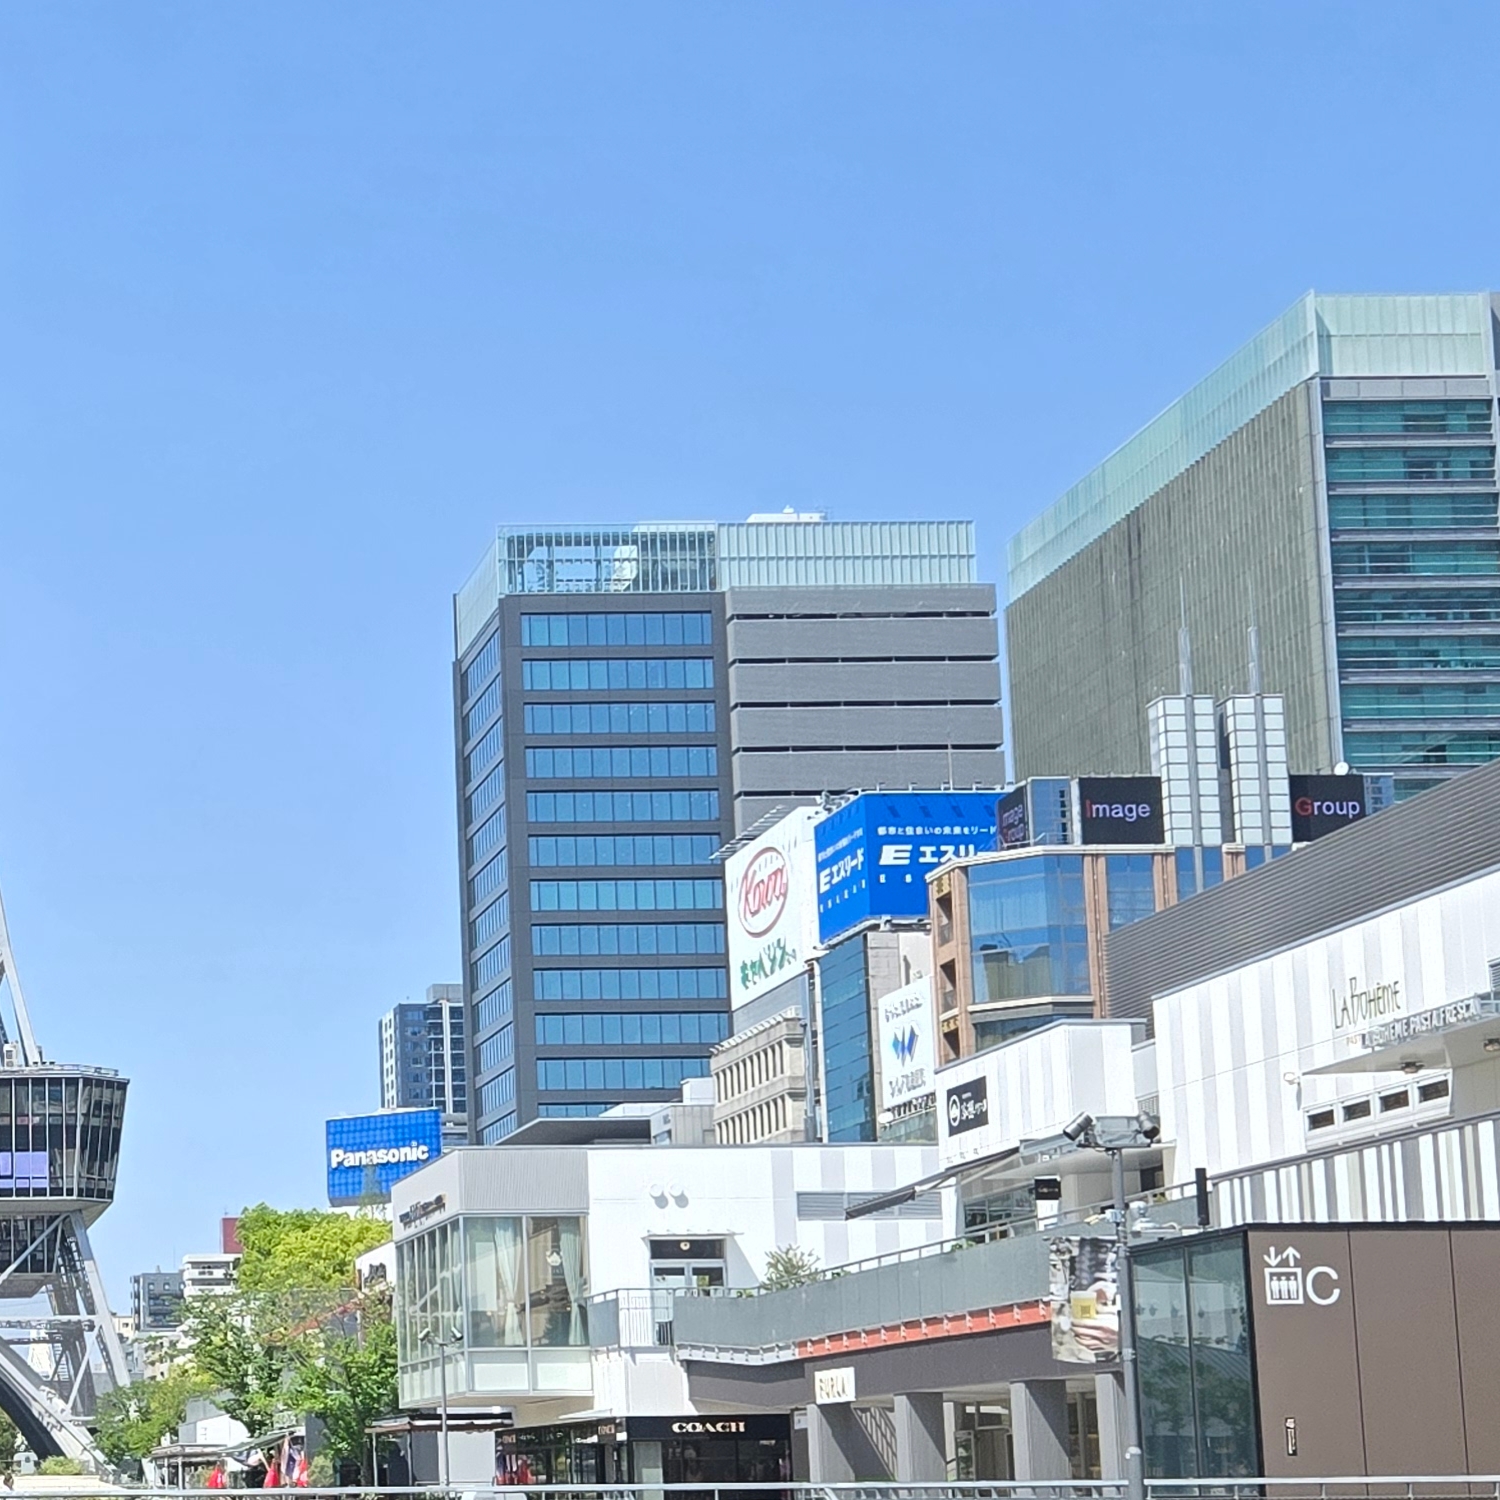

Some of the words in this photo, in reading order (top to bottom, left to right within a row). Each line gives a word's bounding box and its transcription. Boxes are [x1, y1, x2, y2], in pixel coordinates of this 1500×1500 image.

[1086, 800, 1151, 822] Image
[1294, 796, 1361, 819] Group
[330, 1141, 429, 1168] Panasonic
[671, 1421, 746, 1434] COACH
